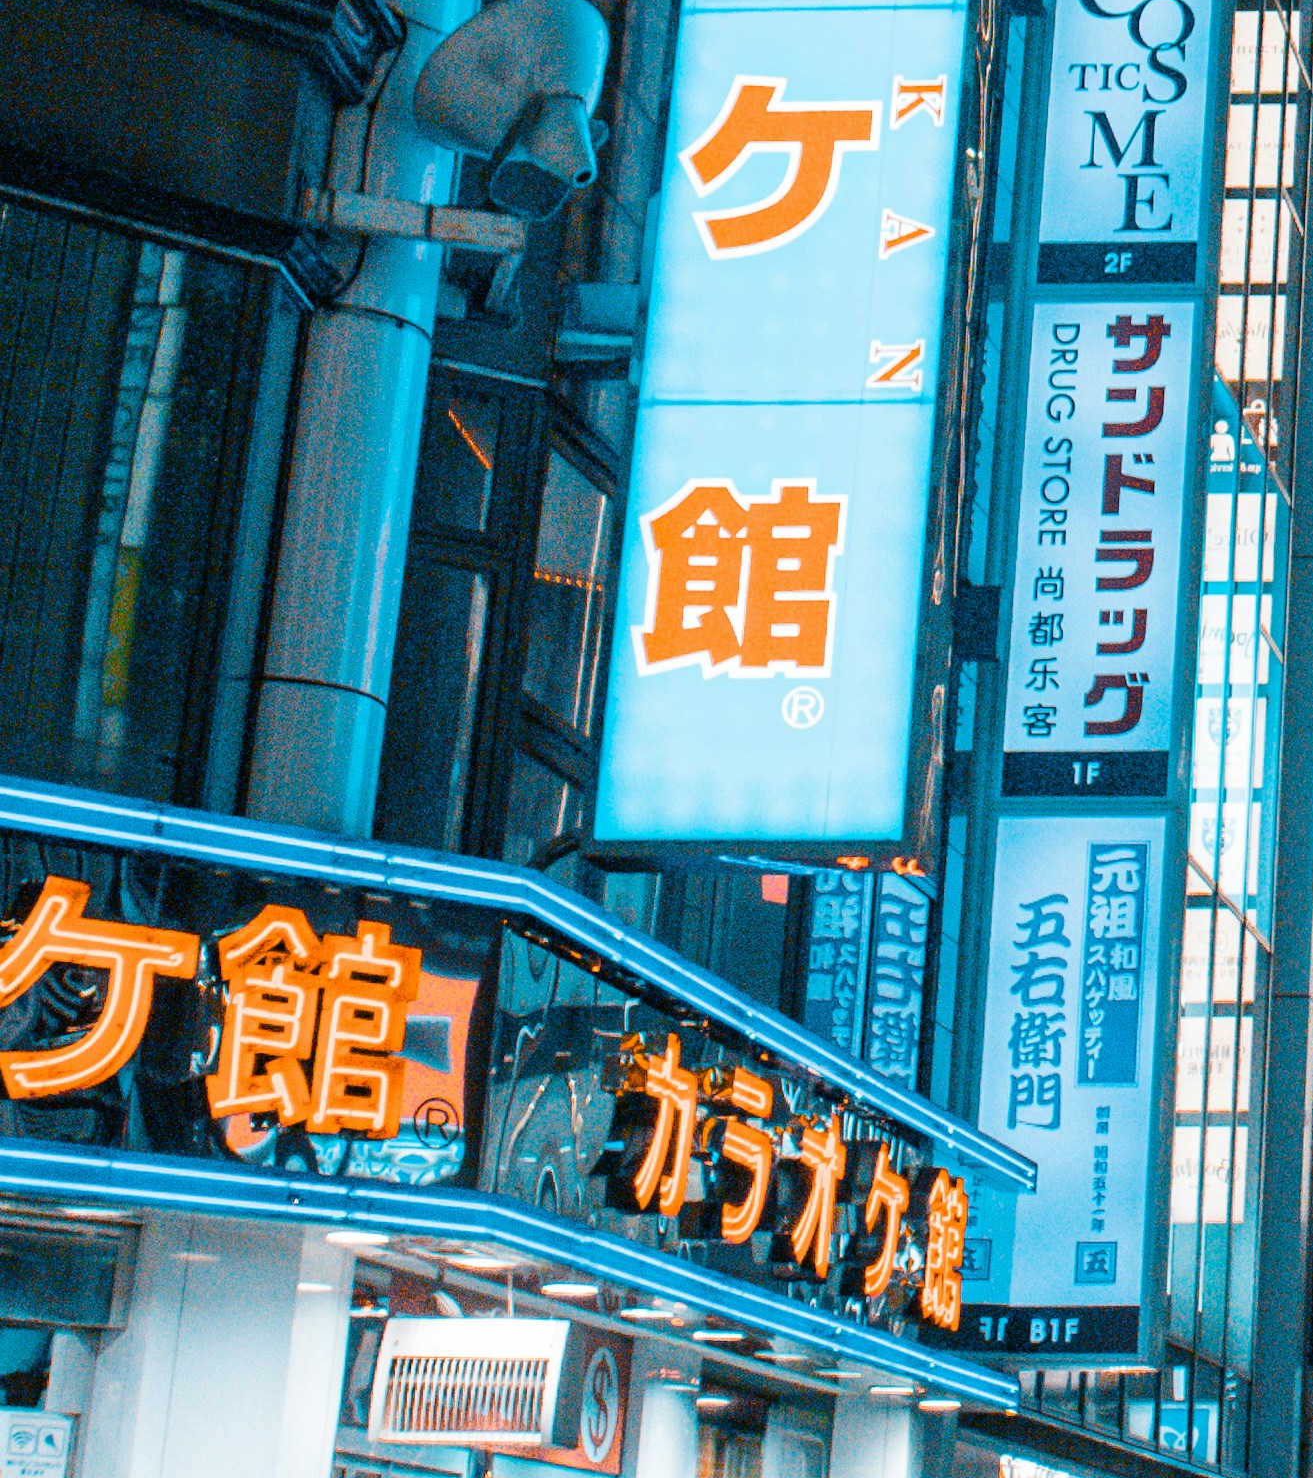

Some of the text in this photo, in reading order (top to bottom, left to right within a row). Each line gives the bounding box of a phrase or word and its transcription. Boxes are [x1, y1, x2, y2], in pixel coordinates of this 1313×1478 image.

[1103, 252, 1133, 274] 2F
[1036, 321, 1082, 547] DRUG STORE
[1082, 313, 1173, 739] サンドラッグ
[1021, 565, 1066, 739] 尚都乐客
[1071, 760, 1101, 785] 1F
[1088, 848, 1141, 940] 元祖
[1006, 893, 1071, 1131] 五右衛門
[1029, 1316, 1080, 1344] B1F
